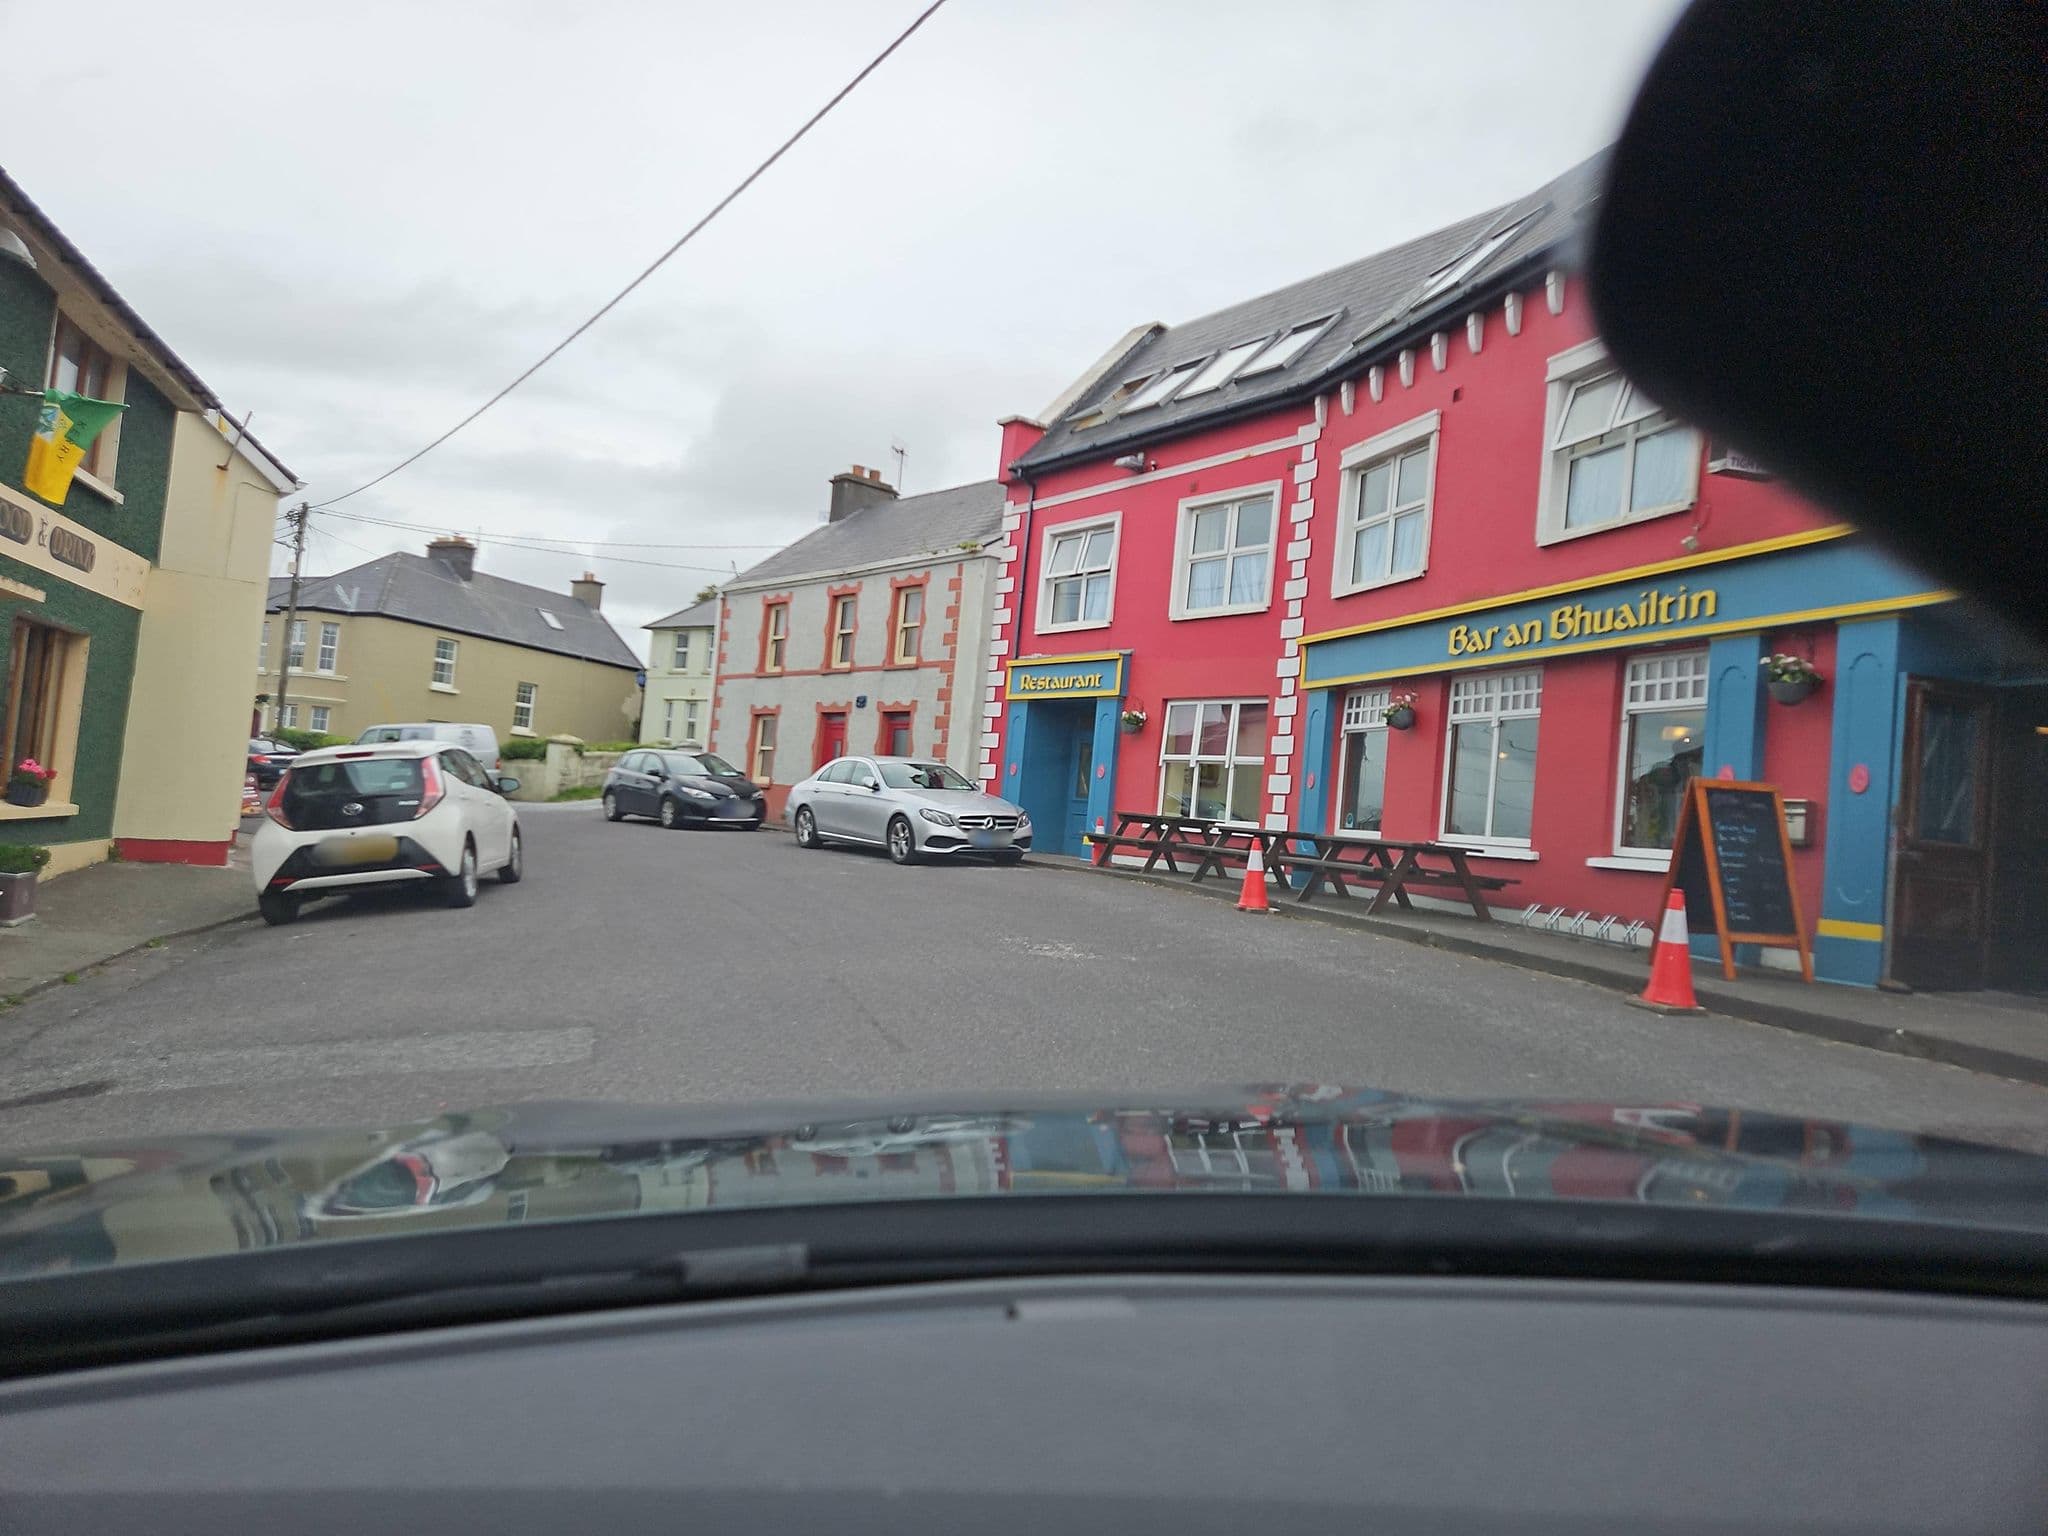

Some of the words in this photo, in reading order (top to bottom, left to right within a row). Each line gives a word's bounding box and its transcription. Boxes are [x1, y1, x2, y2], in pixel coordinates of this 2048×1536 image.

[0, 500, 33, 540] OOD
[1448, 623, 1500, 656] Bar
[1502, 618, 1544, 648] an
[1020, 672, 1104, 691] Restaurant
